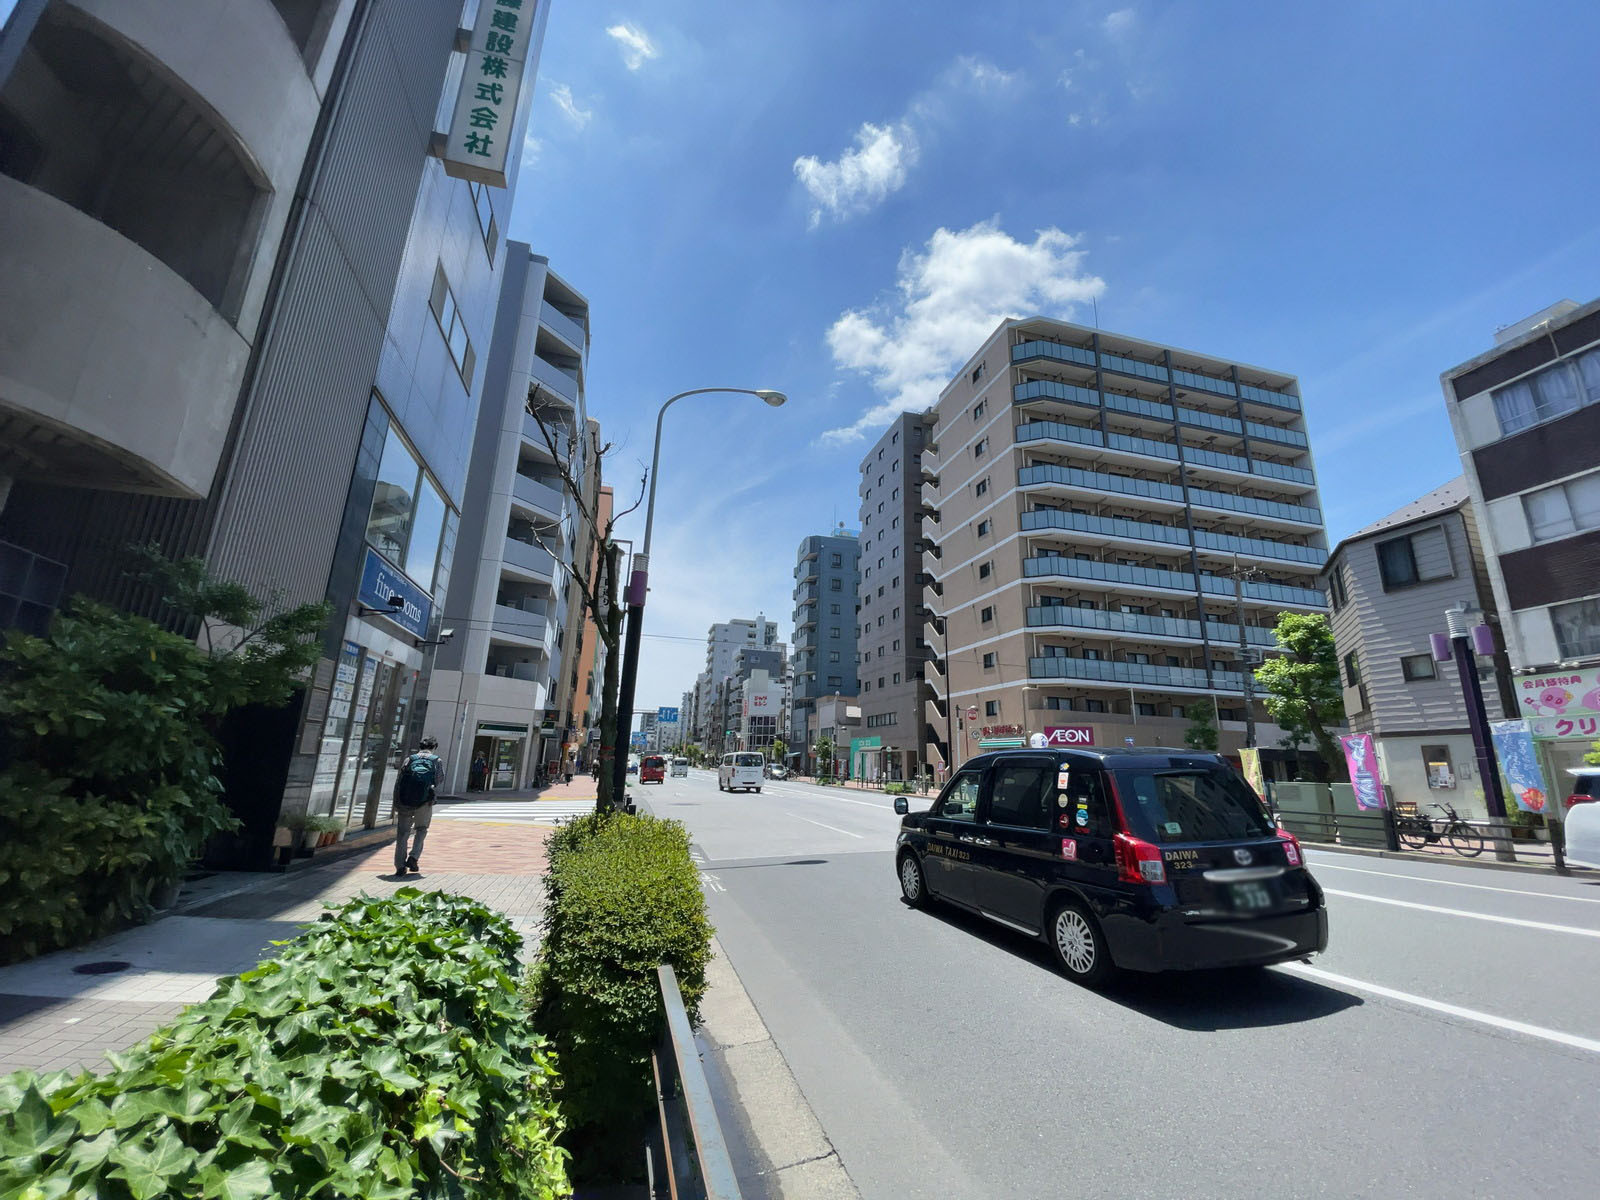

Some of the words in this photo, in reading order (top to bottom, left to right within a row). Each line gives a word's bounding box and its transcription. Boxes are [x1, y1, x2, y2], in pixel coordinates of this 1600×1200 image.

[374, 572, 394, 601] fine
[1523, 675, 1582, 689] 会員様特典
[927, 842, 943, 854] DAIWA
[945, 846, 959, 858] TAXI
[959, 850, 970, 860] 323
[1165, 850, 1199, 861] DAIWA
[1173, 861, 1193, 870] 323
